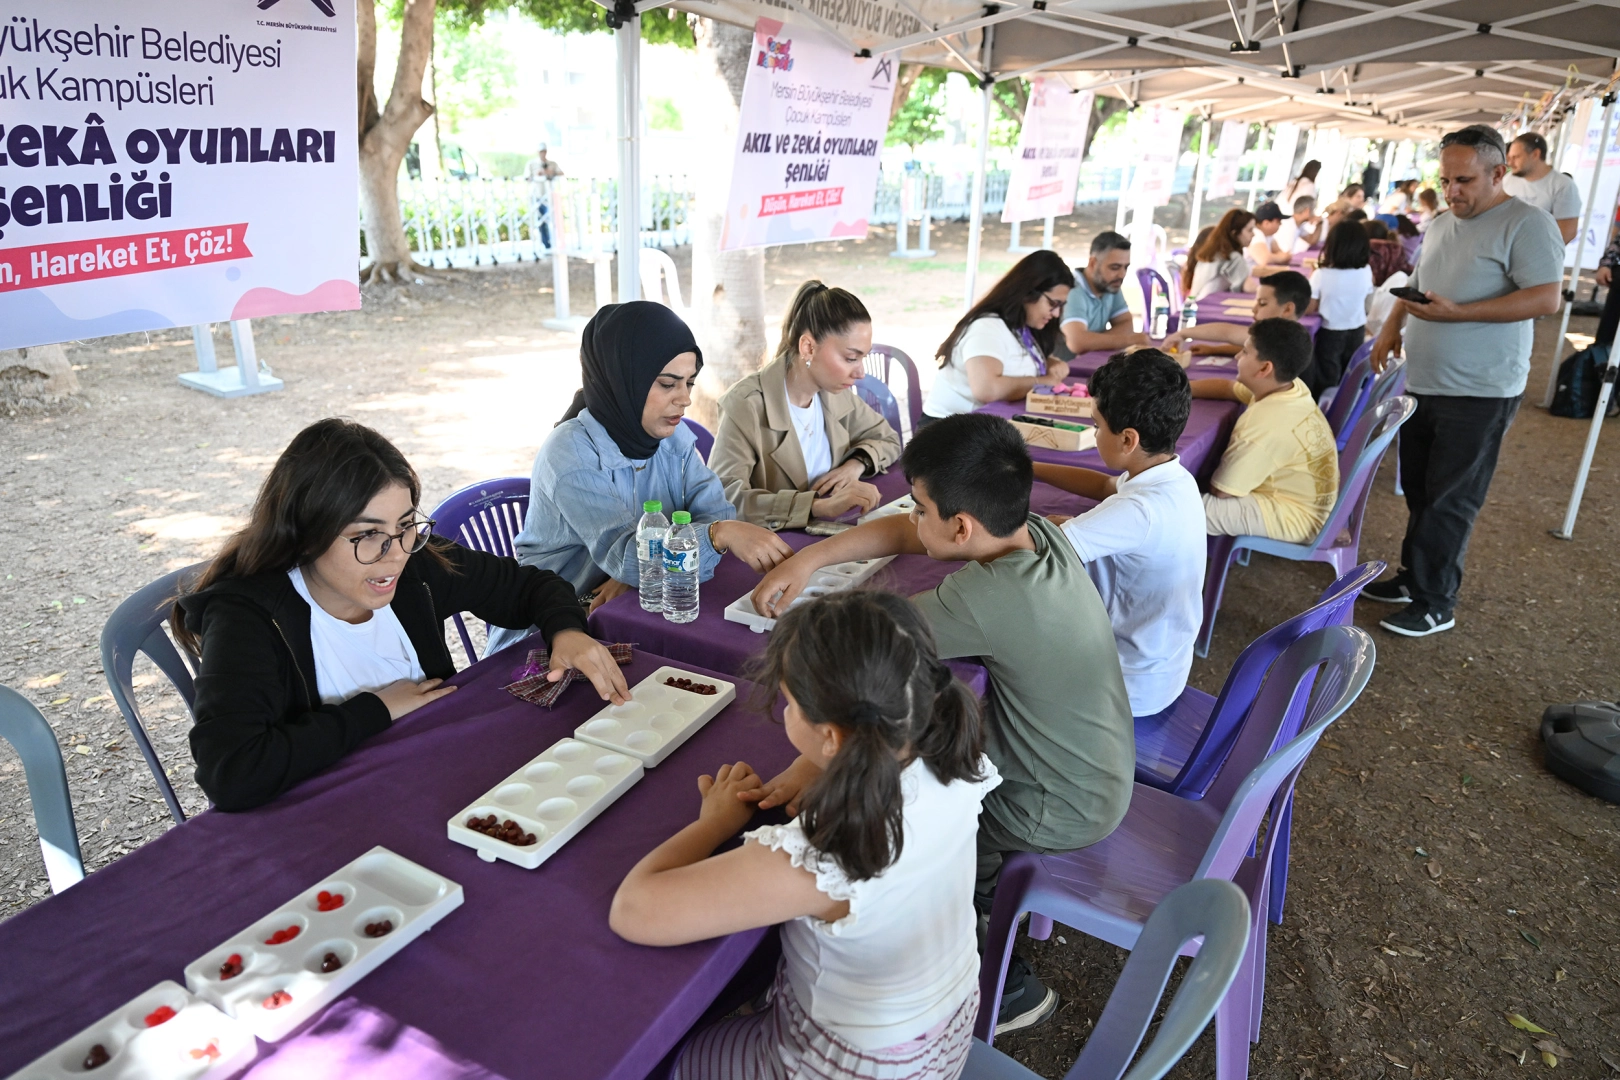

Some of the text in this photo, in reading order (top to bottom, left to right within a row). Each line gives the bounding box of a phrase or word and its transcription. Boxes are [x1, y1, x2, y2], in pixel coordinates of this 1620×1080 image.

[285, 22, 313, 31] BÜYÜKŞEHİR
[313, 25, 337, 33] BELEDİYESİ
[141, 27, 282, 73] Belediyesi
[36, 67, 214, 110] Kampüsleri
[742, 132, 772, 153] AKIL
[30, 238, 138, 280] Hareket
[145, 238, 177, 265] Et,
[185, 228, 233, 265] Çöz!
